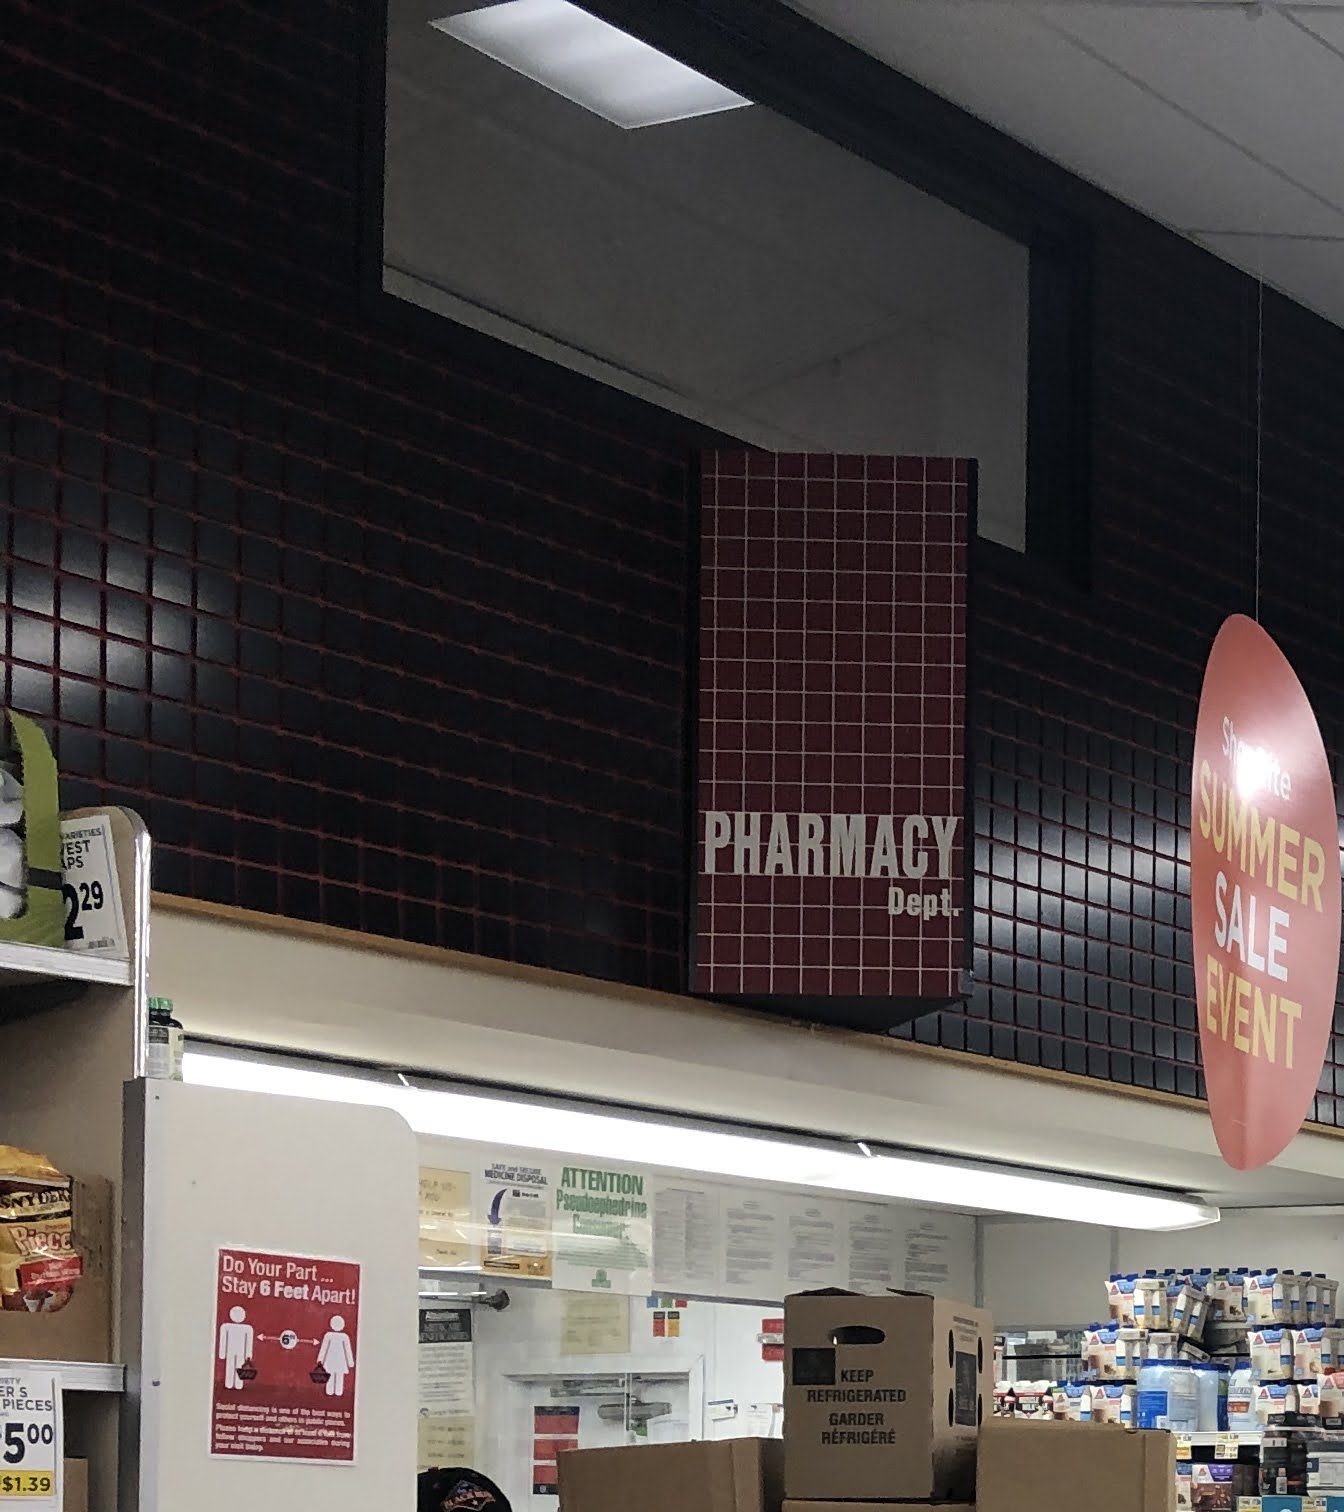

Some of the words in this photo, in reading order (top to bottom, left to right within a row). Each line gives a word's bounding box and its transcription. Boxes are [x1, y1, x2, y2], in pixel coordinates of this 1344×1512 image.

[705, 811, 958, 879] PHARMACY
[1200, 760, 1326, 912] SUMMER
[888, 887, 960, 920] Dept.
[1215, 871, 1290, 982] SALE
[1207, 954, 1302, 1069] EVENT
[561, 1167, 643, 1195] ATTENTION
[222, 1256, 244, 1273] Do
[248, 1258, 285, 1277] Your
[287, 1263, 317, 1280] Part
[221, 1276, 257, 1298] Stay
[260, 1281, 271, 1295] 6
[274, 1282, 309, 1299] Feet
[311, 1289, 356, 1305] Apart!
[840, 1370, 874, 1382] KEEP
[3, 1399, 53, 1411] PIECES
[807, 1390, 906, 1402] REFRIGERATED
[829, 1413, 884, 1426] GARDER
[821, 1428, 896, 1444] RÉFRIGÉRÉ
[2, 1475, 51, 1492] $1.39
